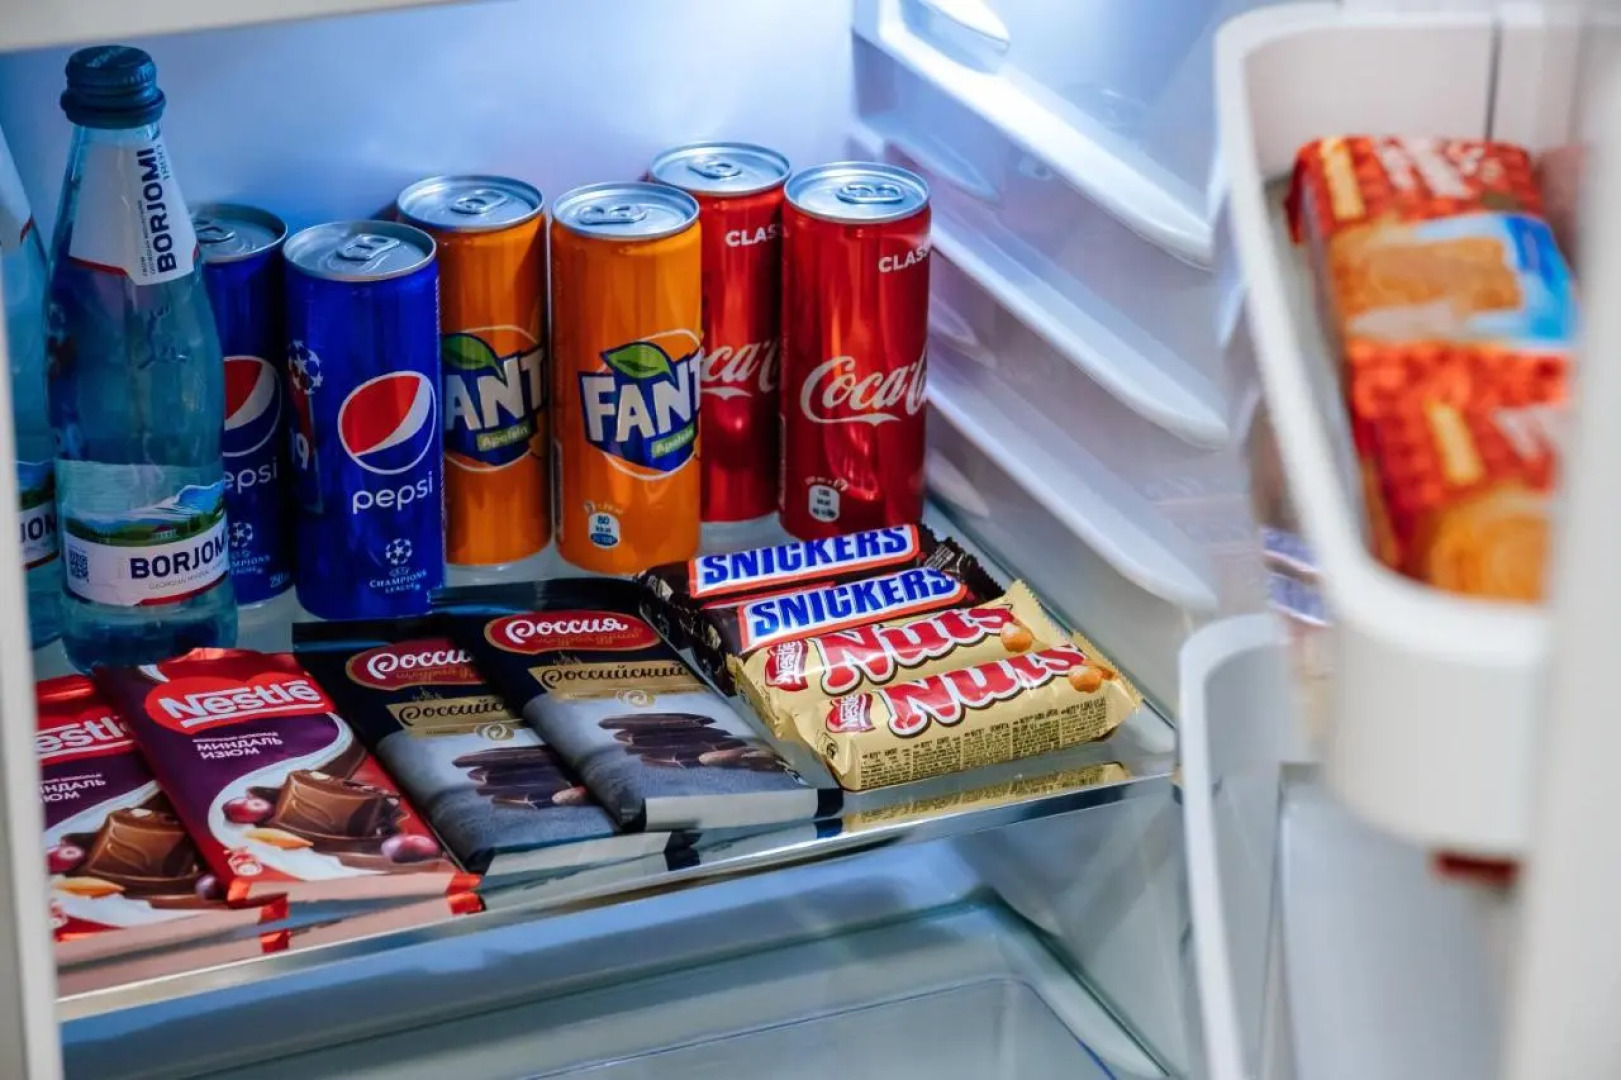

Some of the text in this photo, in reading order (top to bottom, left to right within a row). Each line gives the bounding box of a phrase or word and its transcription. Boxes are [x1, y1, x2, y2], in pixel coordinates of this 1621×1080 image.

[136, 147, 177, 273] BORJOMI
[352, 470, 433, 515] pepsi
[703, 525, 908, 585] SNICKERS
[505, 617, 628, 644] Россия
[751, 568, 955, 637] SNICKERS
[815, 606, 1015, 694] Nuts
[880, 645, 1086, 736] Nuts
[196, 737, 284, 752] МИНДАЛЬ
[200, 747, 260, 760] ИЗЮМ
